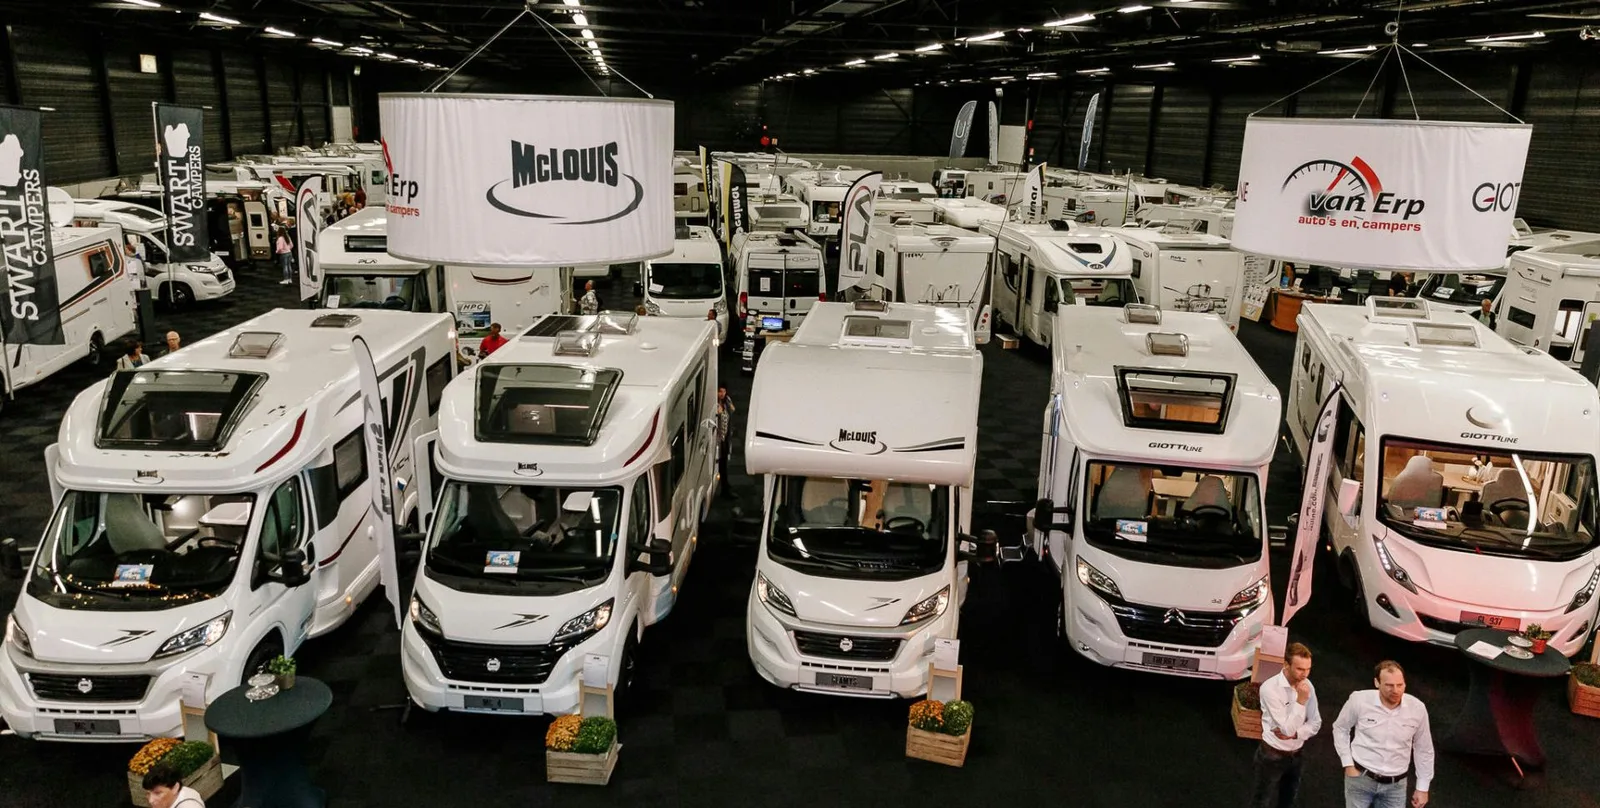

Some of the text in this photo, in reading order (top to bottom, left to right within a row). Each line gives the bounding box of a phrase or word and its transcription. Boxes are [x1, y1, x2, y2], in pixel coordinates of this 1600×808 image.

[168, 159, 195, 247] SWART
[189, 145, 204, 209] CAMPERS
[392, 173, 418, 204] Erp
[1310, 192, 1425, 220] van Erp
[23, 169, 48, 266] CAMPERS
[1298, 216, 1422, 233] auto's en campers
[0, 189, 40, 321] SWART
